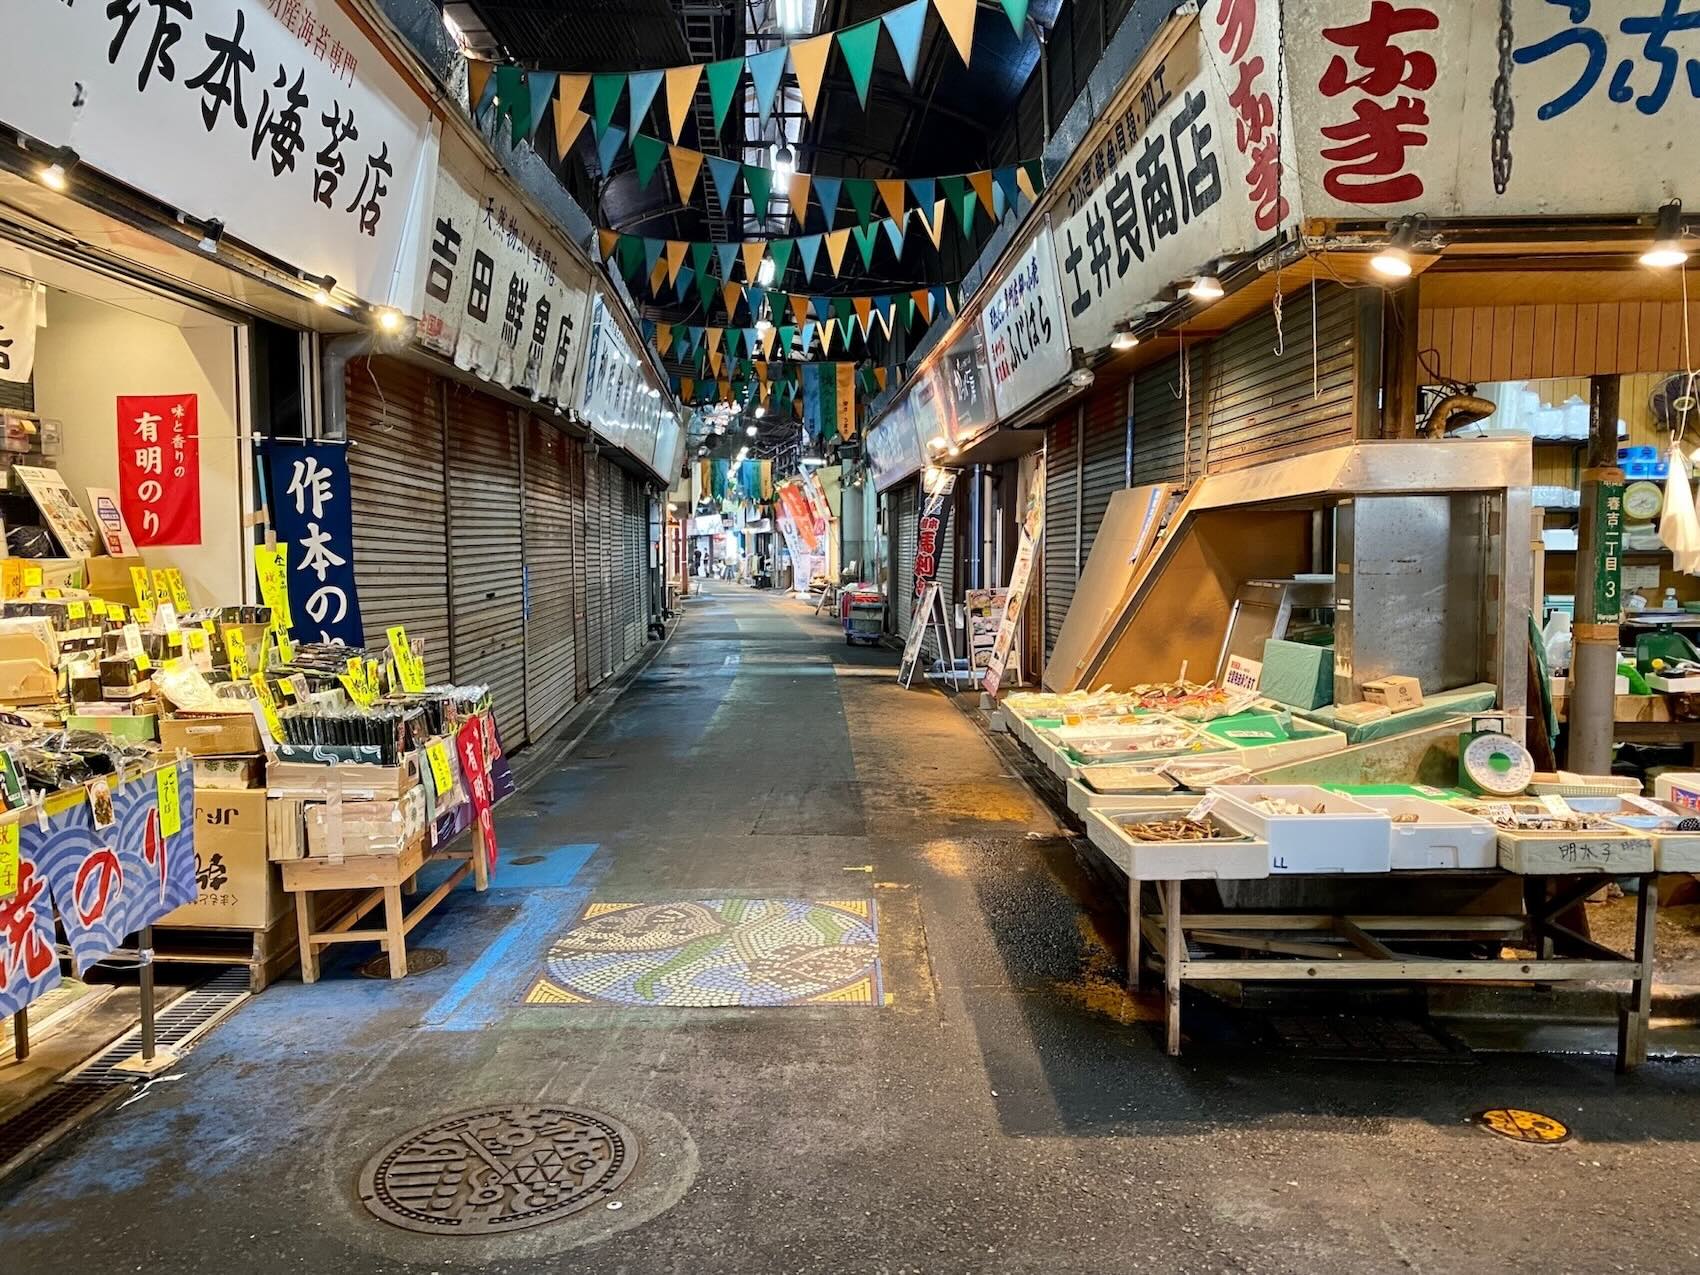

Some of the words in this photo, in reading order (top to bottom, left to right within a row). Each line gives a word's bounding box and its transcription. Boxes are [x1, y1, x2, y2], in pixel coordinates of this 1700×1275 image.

[107, 0, 393, 237] 作本海苔店
[1065, 90, 1223, 319] 土井良商店
[425, 217, 574, 385] 吉田鮮魚店
[134, 411, 163, 538] 有明のり
[171, 404, 186, 478] 味と香りの
[1605, 497, 1619, 571] 春吉一丁目
[1604, 580, 1616, 598] 3
[1273, 856, 1288, 869] LL
[1558, 842, 1612, 863] 明太子
[190, 892, 239, 906] くまもと
